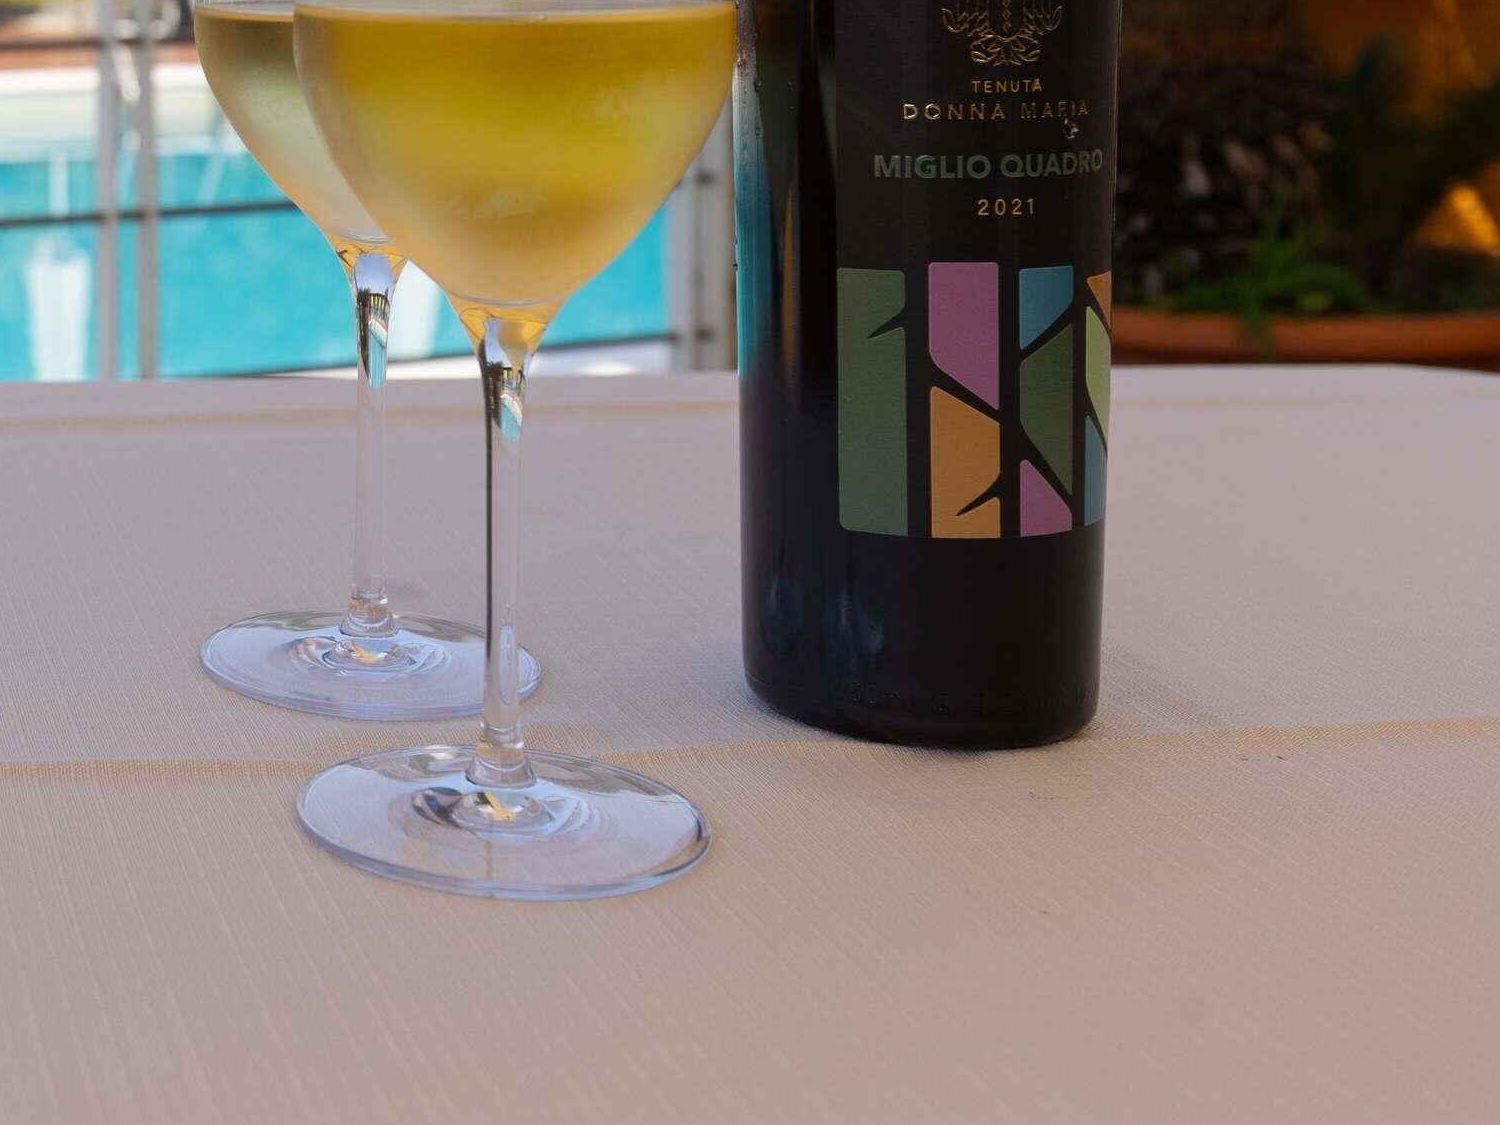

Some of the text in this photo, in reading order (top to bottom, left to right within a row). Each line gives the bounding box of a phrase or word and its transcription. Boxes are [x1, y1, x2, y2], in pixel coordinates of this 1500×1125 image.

[972, 78, 1043, 93] TENUTA
[902, 100, 1091, 120] DONNA MARIA
[873, 148, 1103, 179] MIGLIO QUADRO
[977, 198, 1036, 216] 2021
